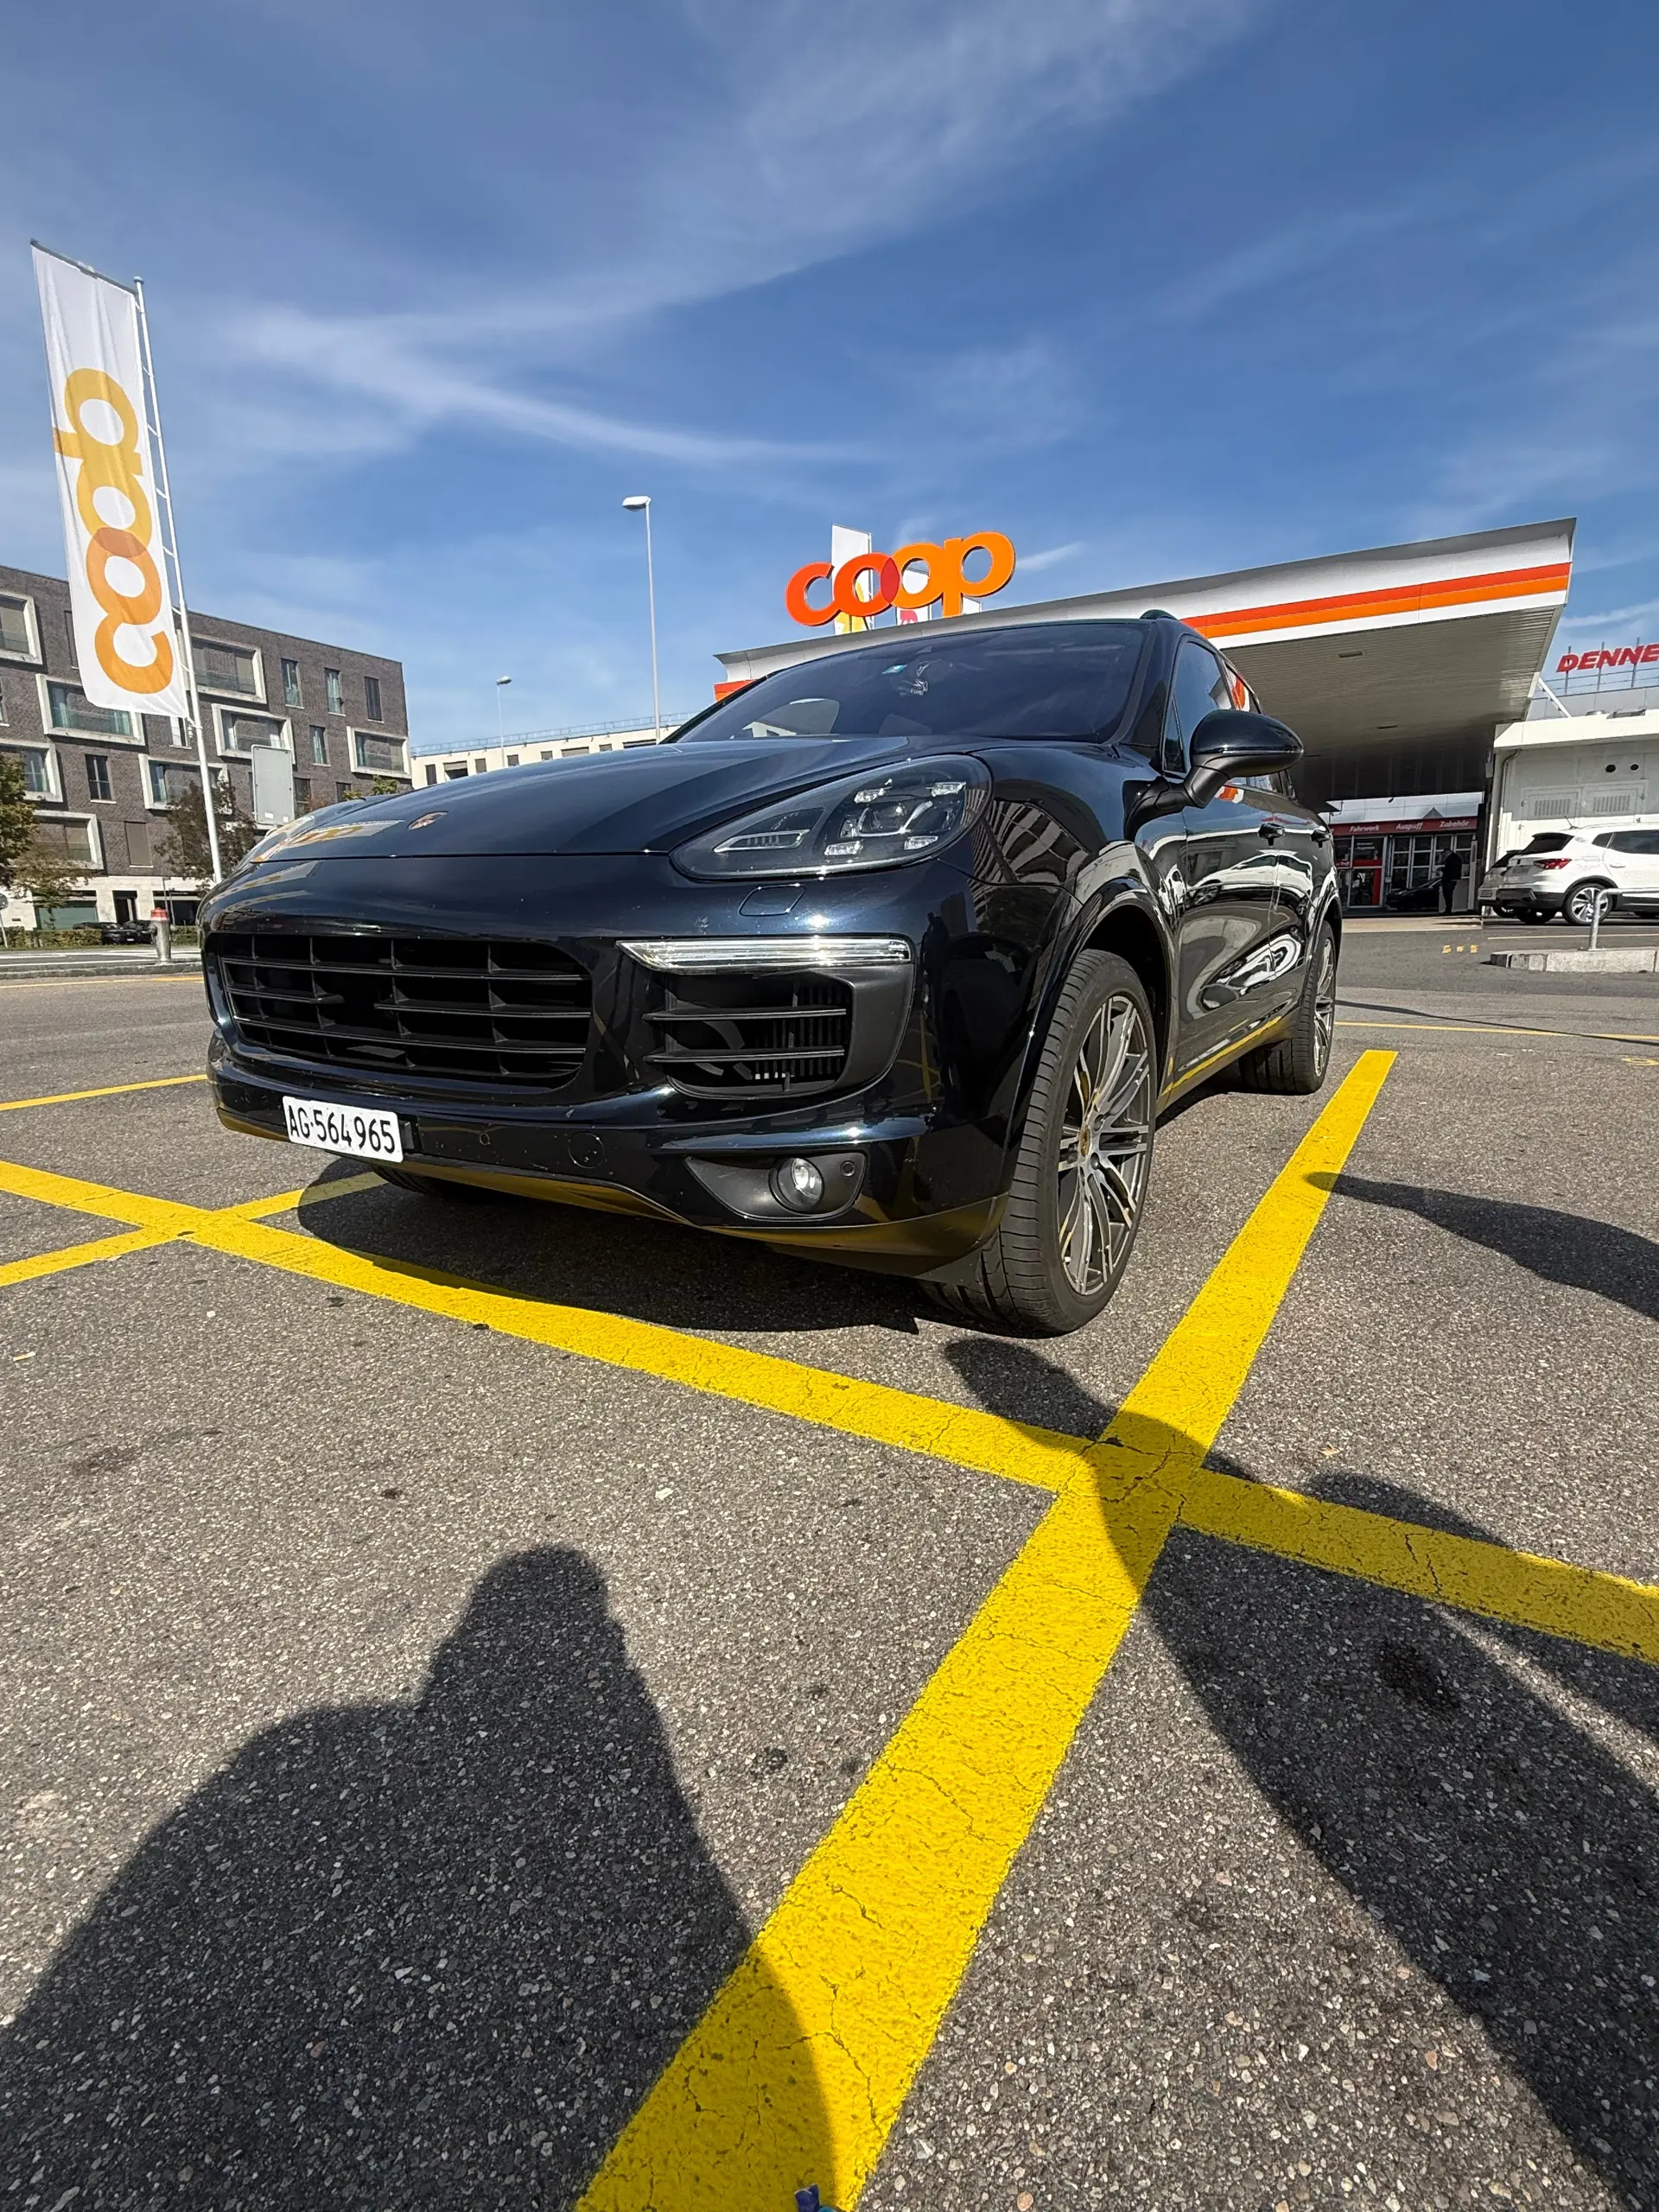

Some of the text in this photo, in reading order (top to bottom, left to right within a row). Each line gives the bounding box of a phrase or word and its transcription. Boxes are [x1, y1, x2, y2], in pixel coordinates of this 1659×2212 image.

[785, 531, 1016, 626] coop
[1349, 819, 1470, 833] Fahrwerk Auspuff Zubehör
